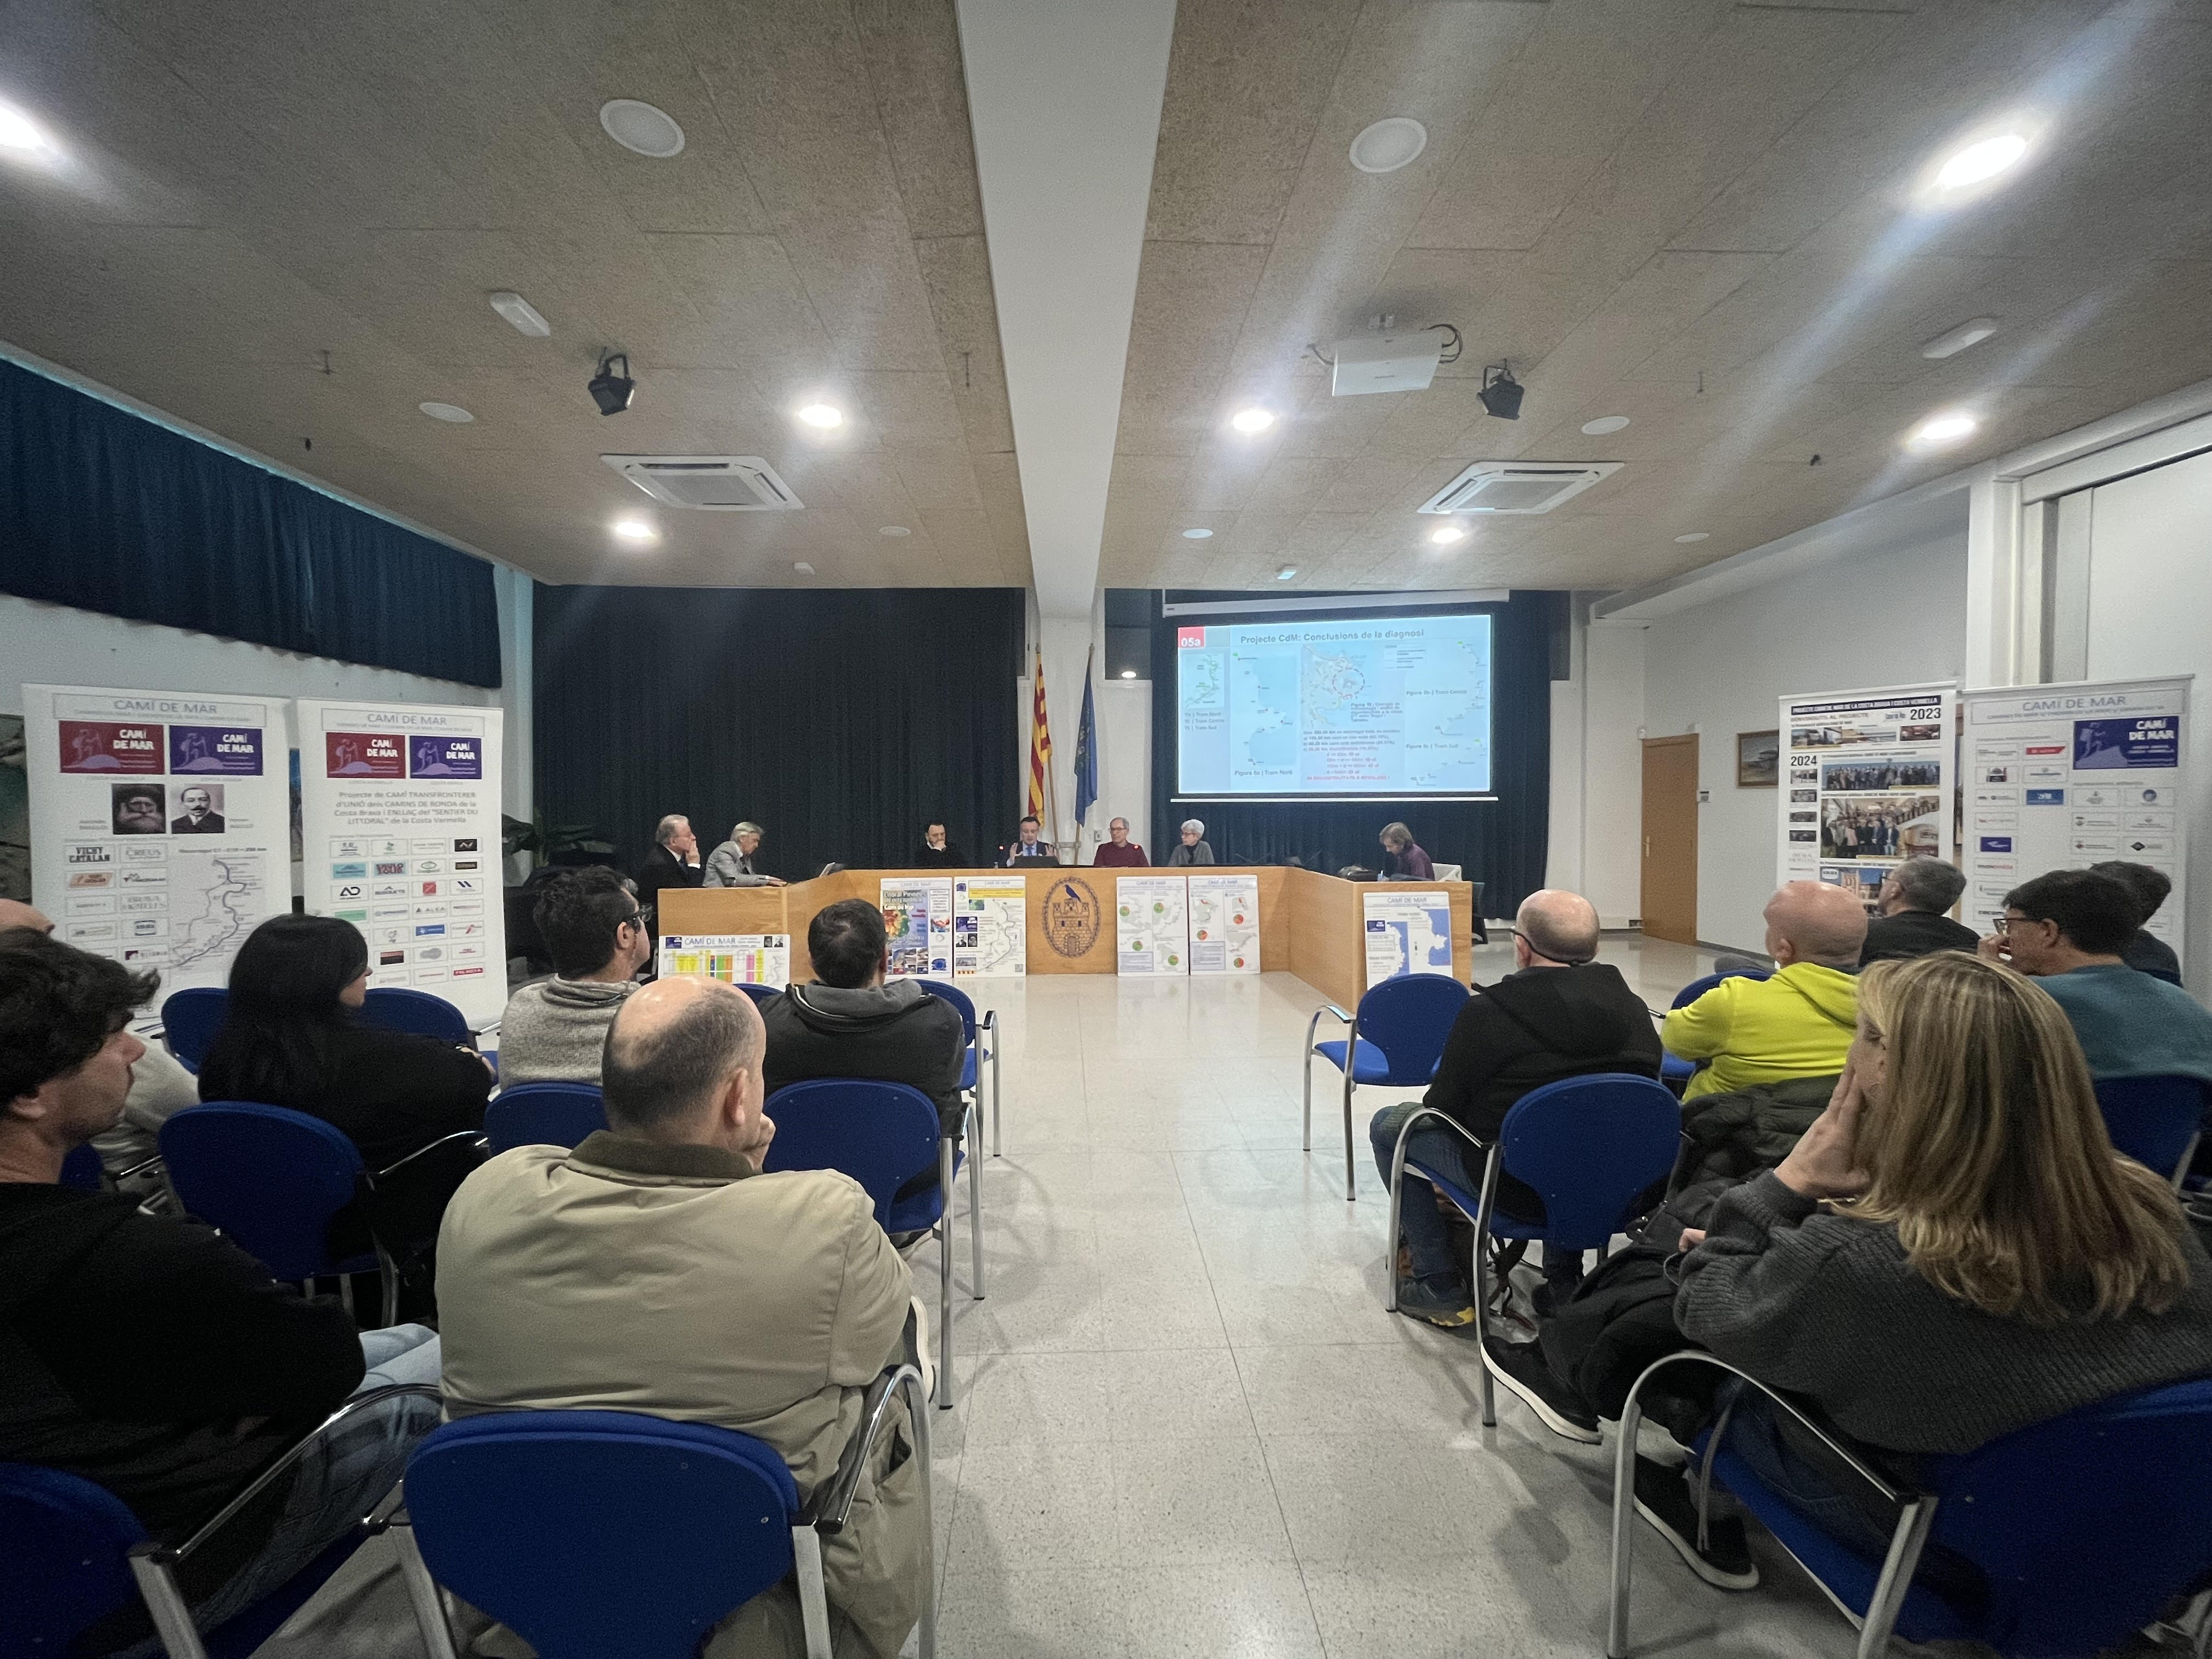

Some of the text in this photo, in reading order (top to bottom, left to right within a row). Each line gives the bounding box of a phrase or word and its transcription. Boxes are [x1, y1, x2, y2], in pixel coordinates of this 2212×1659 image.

[1278, 634, 1301, 642] CdM:
[1304, 632, 1358, 641] Conclusions
[1385, 629, 1425, 639] diagnosi
[1181, 637, 1201, 647] 05a
[114, 699, 217, 714] CAMÍ DE MAR
[2023, 699, 2061, 712] CAMÍ
[2066, 698, 2083, 709] DE
[2090, 696, 2126, 707] MAR
[368, 713, 447, 725] CAMÍ DE MAR
[1910, 708, 1941, 720] 2023
[119, 729, 146, 739] CAMÍ
[222, 733, 247, 743] CAMÍ
[2129, 730, 2175, 741] DE MAR
[113, 740, 154, 751] DE MAR
[371, 738, 393, 748] CAMÍ
[450, 742, 470, 751] CAMÍ
[217, 744, 254, 753] DE MAR
[380, 749, 398, 757] MAR
[446, 751, 475, 760] DE MAR
[1791, 755, 1817, 766] 2024
[684, 936, 704, 945] CAMÍ
